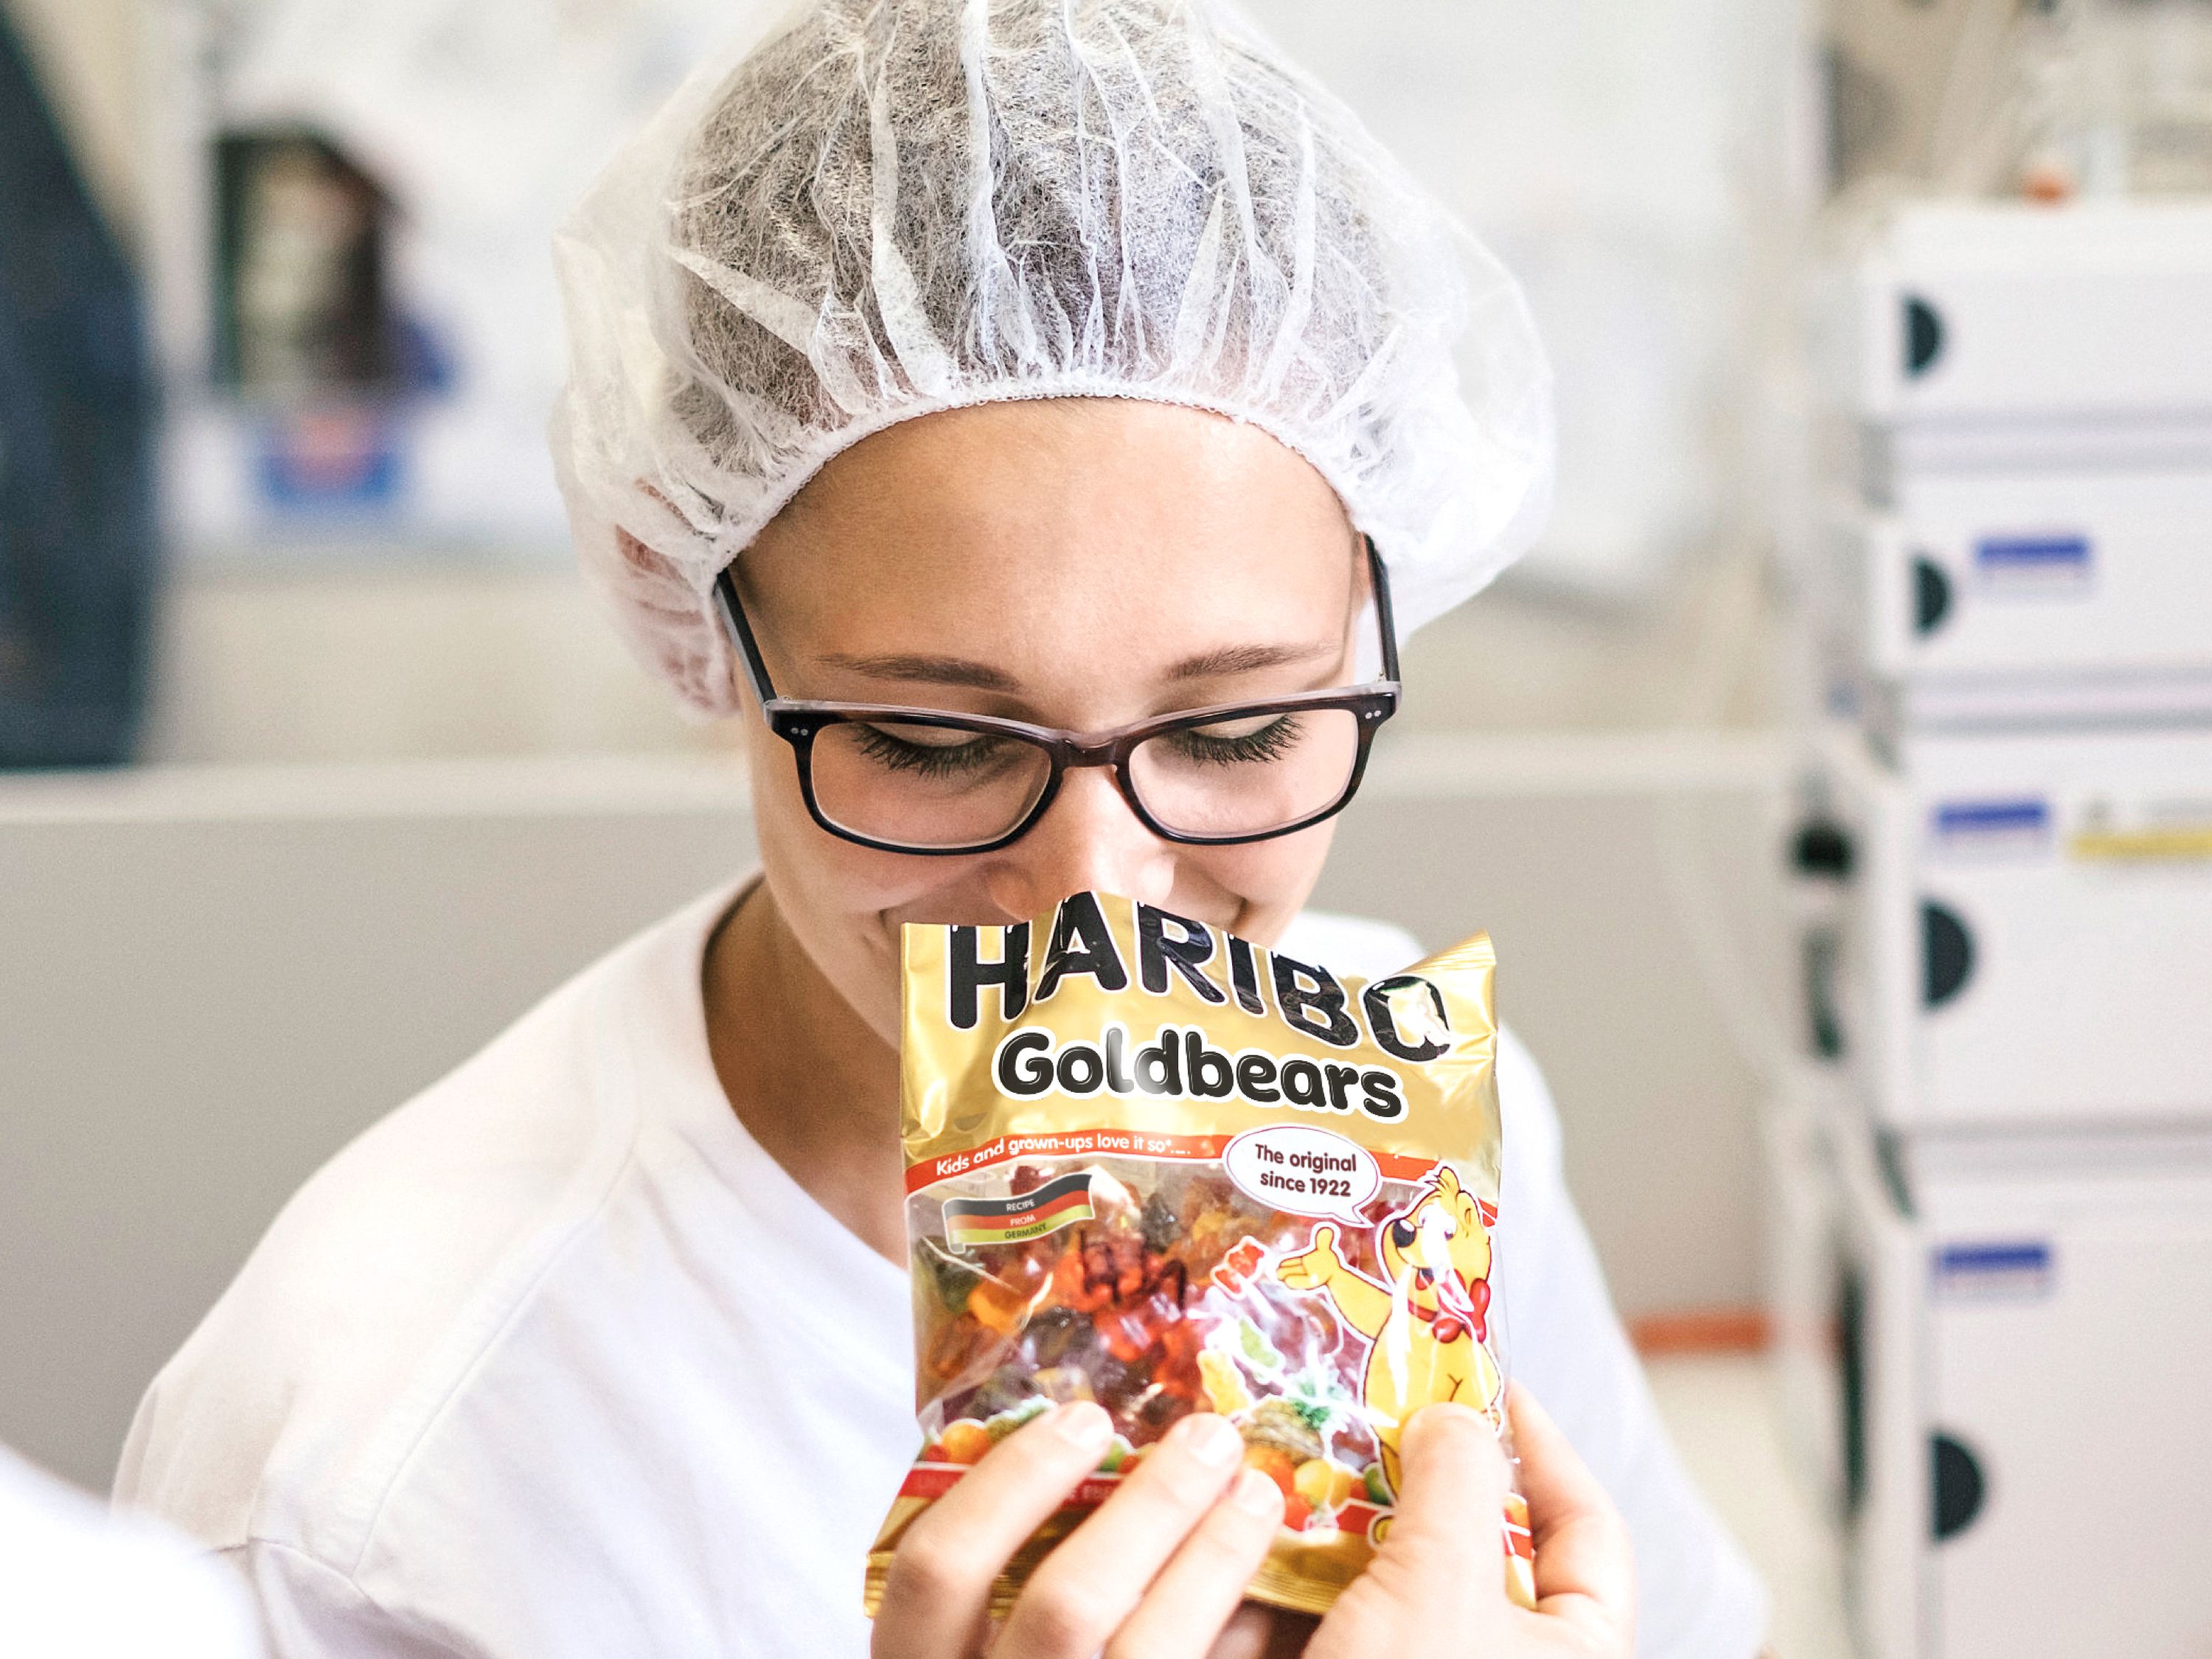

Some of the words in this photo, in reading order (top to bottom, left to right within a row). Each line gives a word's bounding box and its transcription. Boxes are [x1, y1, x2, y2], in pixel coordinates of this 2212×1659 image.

[949, 889, 1451, 1062] HARIBO
[998, 1027, 1402, 1118] Goldbears
[936, 1154, 970, 1176] Kids
[973, 1138, 1005, 1164] and
[1008, 1137, 1093, 1156] grown-ups
[1097, 1133, 1130, 1149] love
[1133, 1135, 1144, 1150] it
[1255, 1143, 1284, 1164] The
[1290, 1151, 1357, 1174] original
[1260, 1171, 1306, 1193] since
[1310, 1178, 1352, 1197] 1922
[1006, 1199, 1035, 1212] RECIPE
[1004, 1222, 1047, 1239] GERMANY
[1010, 1214, 1037, 1226] FROM
